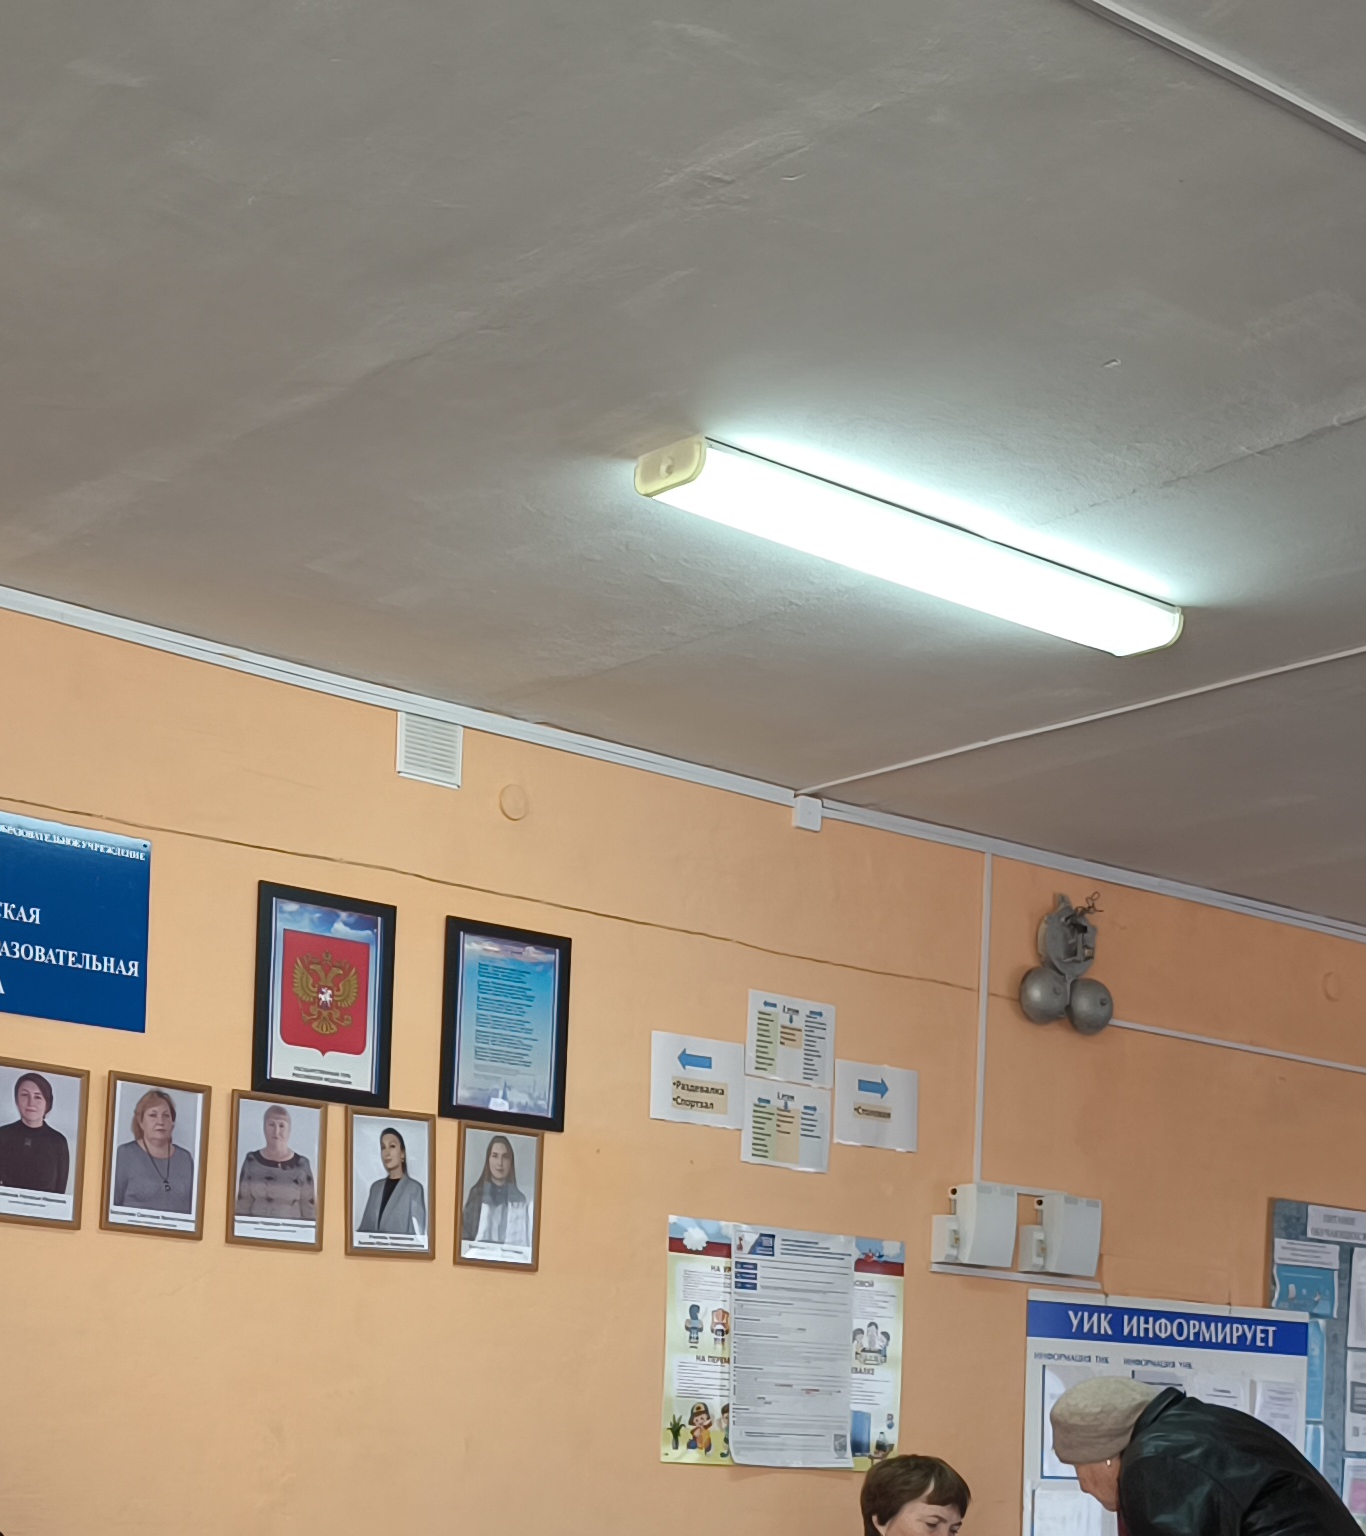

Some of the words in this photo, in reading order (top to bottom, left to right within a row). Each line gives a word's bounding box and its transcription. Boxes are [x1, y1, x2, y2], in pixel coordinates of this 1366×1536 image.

[676, 1080, 725, 1096] Раздевалка
[676, 1096, 714, 1110] Спортзал
[1068, 1310, 1113, 1336] УИК
[1123, 1315, 1277, 1348] ИНФОРМИРУЕТ
[707, 1356, 730, 1365] ПЕРЕМ
